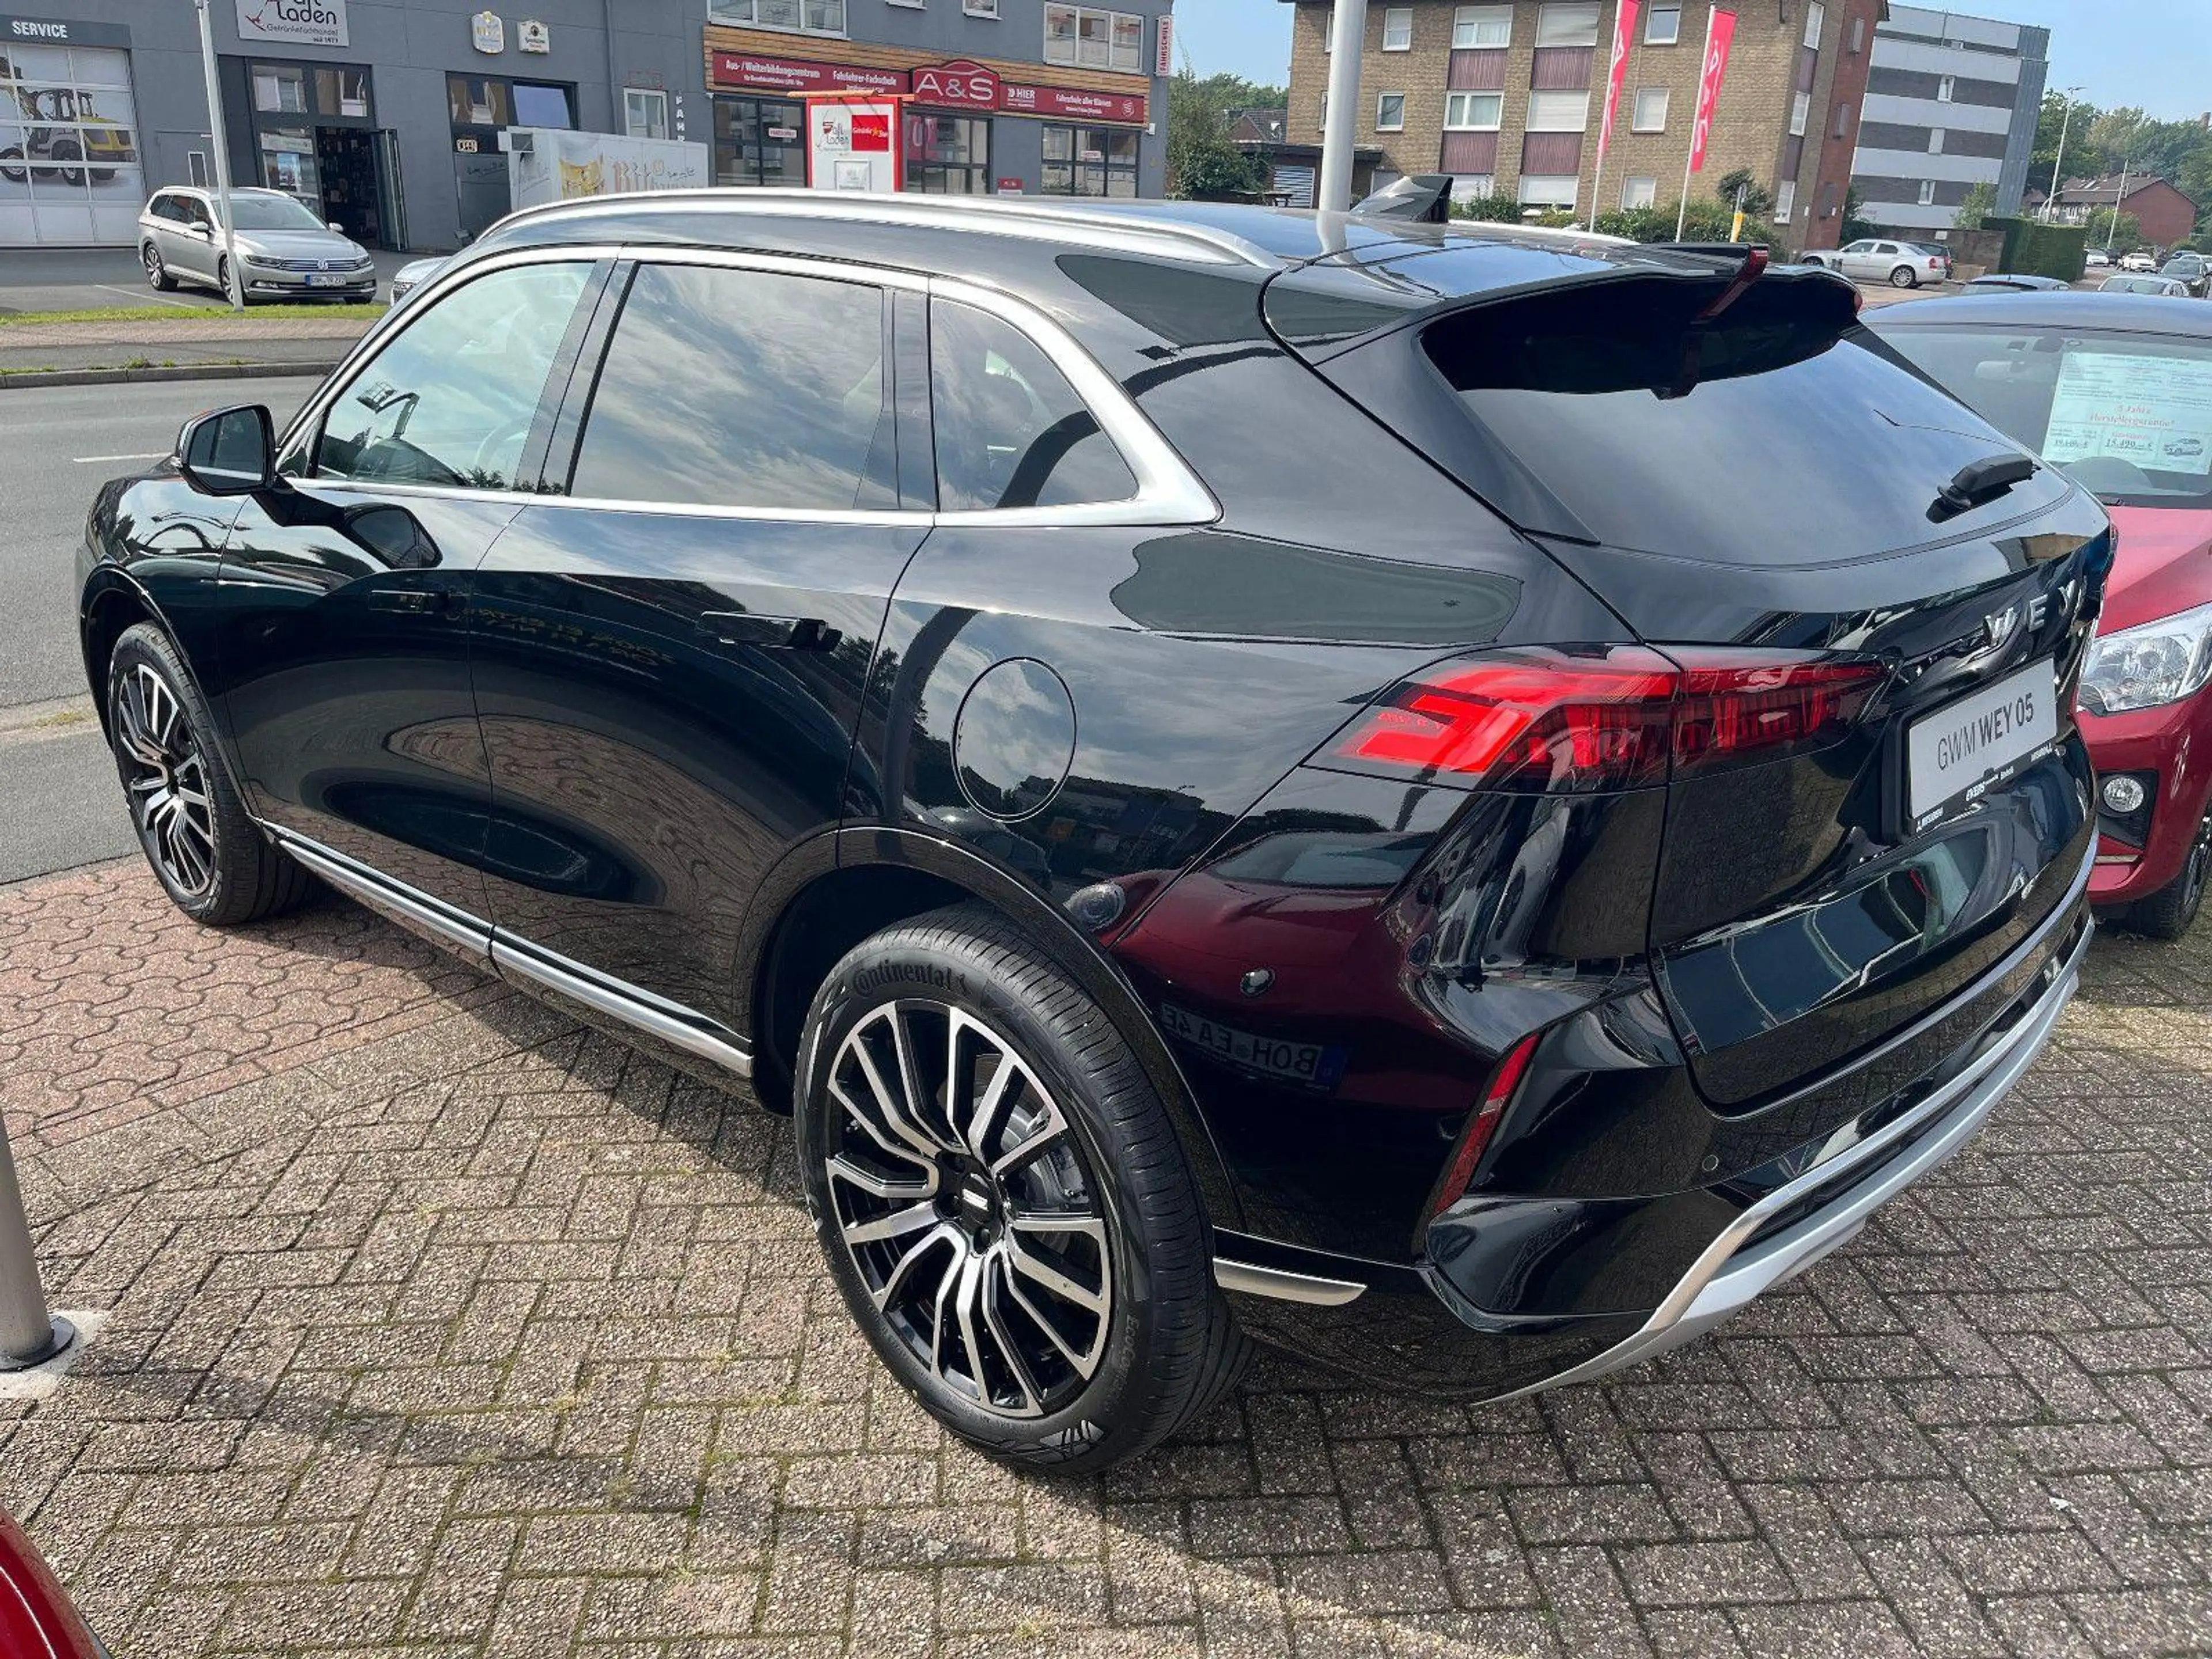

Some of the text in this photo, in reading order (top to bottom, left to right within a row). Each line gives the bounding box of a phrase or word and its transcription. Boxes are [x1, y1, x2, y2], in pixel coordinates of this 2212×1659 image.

[12, 21, 68, 38] SERVICE
[1160, 21, 1169, 71] FAHRSCHULE
[915, 73, 994, 101] A&S
[1016, 89, 1035, 99] HIER
[1938, 692, 2033, 771] GWM WEY 05
[852, 960, 953, 997] Continental
